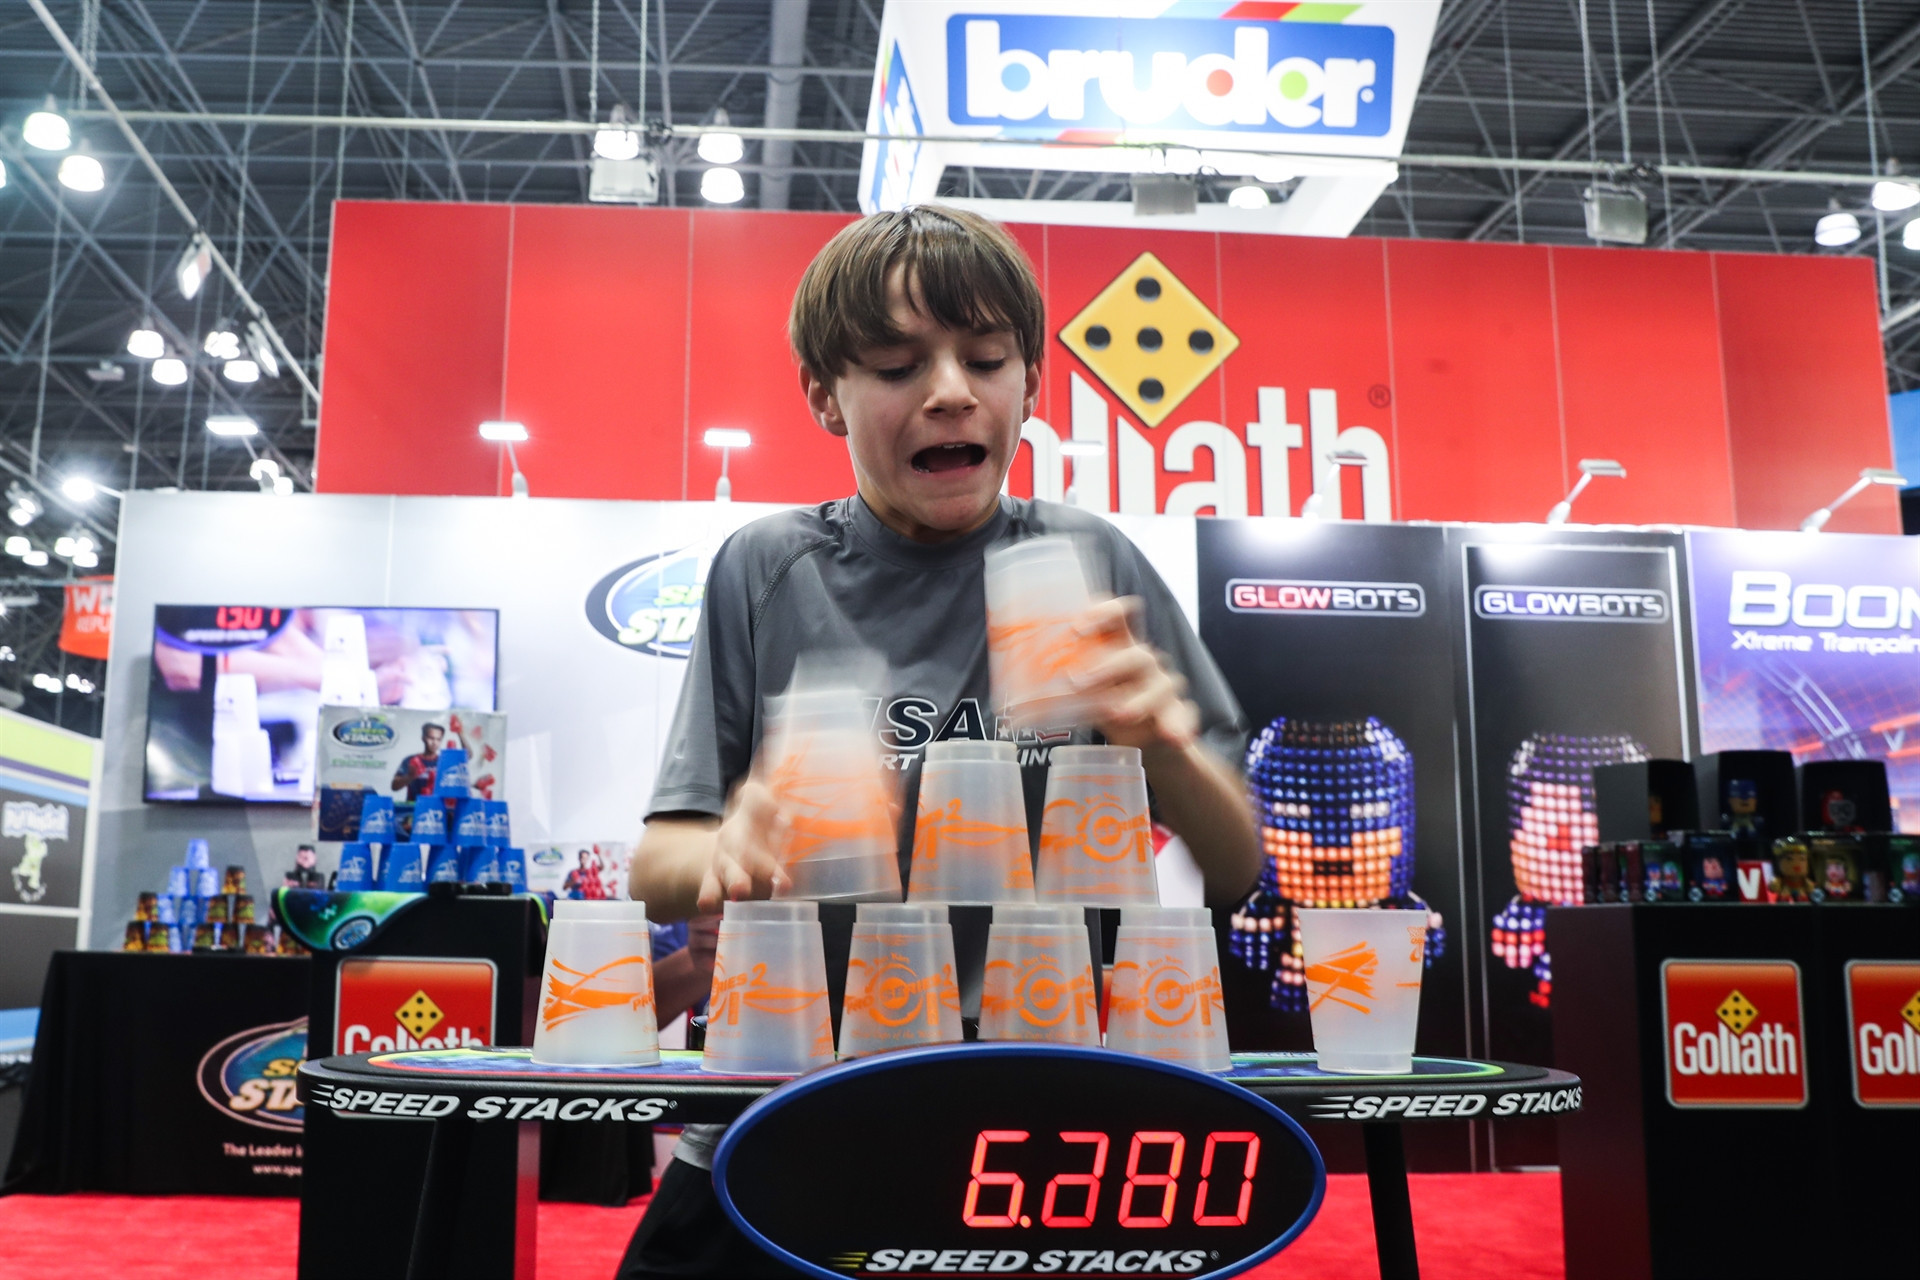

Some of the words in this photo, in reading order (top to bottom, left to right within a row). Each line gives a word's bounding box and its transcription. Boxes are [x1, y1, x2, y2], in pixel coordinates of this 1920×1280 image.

[965, 19, 1376, 129] bruder
[1001, 370, 1393, 521] oliath
[1233, 585, 1420, 611] GLOWBOTS
[1482, 590, 1664, 618] GLOWBOTS
[862, 697, 988, 751] SA
[749, 961, 769, 988] 2
[1673, 1021, 1798, 1076] Goliath
[329, 1087, 461, 1119] SPEED
[466, 1096, 672, 1122] STACKS
[1347, 1094, 1488, 1120] SPEED
[1491, 1086, 1583, 1117] STACKS
[864, 1249, 1030, 1273] SPEED
[1032, 1249, 1208, 1273] STACKS
